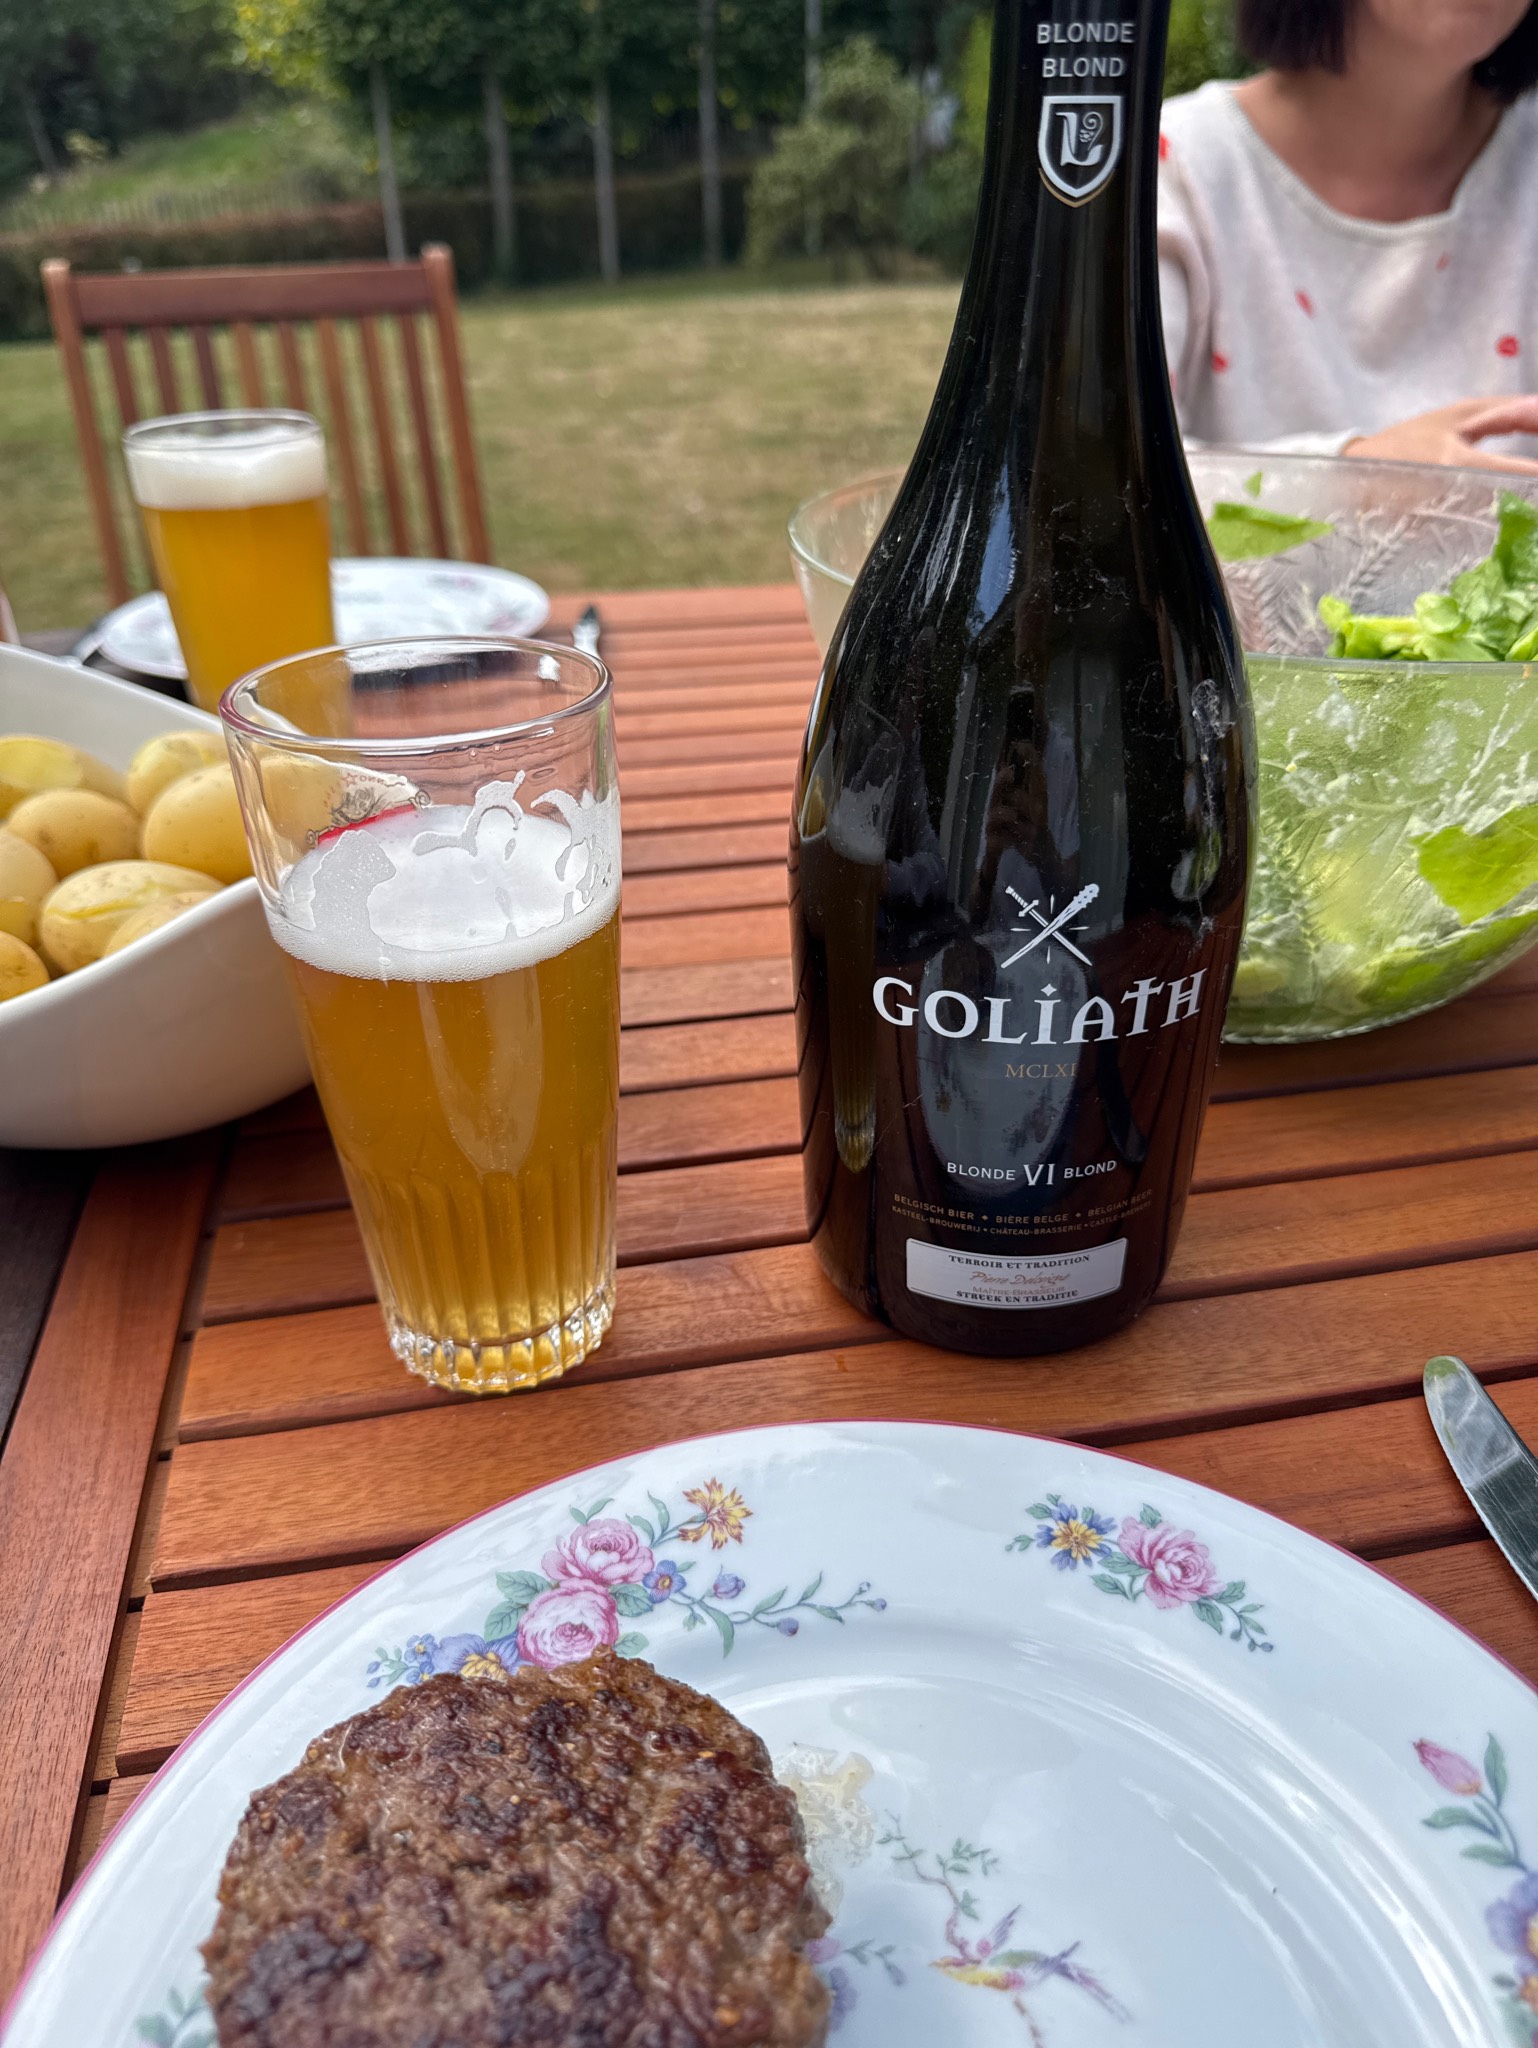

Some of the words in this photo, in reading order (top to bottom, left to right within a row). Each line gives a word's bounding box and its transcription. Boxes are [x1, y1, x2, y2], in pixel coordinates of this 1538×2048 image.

[1037, 22, 1135, 44] BLONDE
[1042, 57, 1125, 78] BLOND
[872, 968, 1208, 1045] GOLIATH
[947, 1162, 1016, 1181] BLONDE
[1023, 1163, 1055, 1186] VI
[1063, 1160, 1117, 1179] BLOND
[894, 1193, 944, 1215] BELGISCH
[948, 1209, 974, 1220] BIER
[996, 1213, 1029, 1224] BIÈRE
[1034, 1213, 1069, 1223] BELGE
[1088, 1199, 1128, 1217] BELGIAN
[1131, 1189, 1152, 1204] BEER
[892, 1205, 981, 1233] KASTEEL-BROUWERIJ
[948, 1254, 1003, 1268] TERROIR
[1025, 1254, 1091, 1269] TRADITION
[956, 1290, 1002, 1302] STREEK
[1006, 1295, 1022, 1303] EN
[1025, 1289, 1079, 1303] TRADITIE
